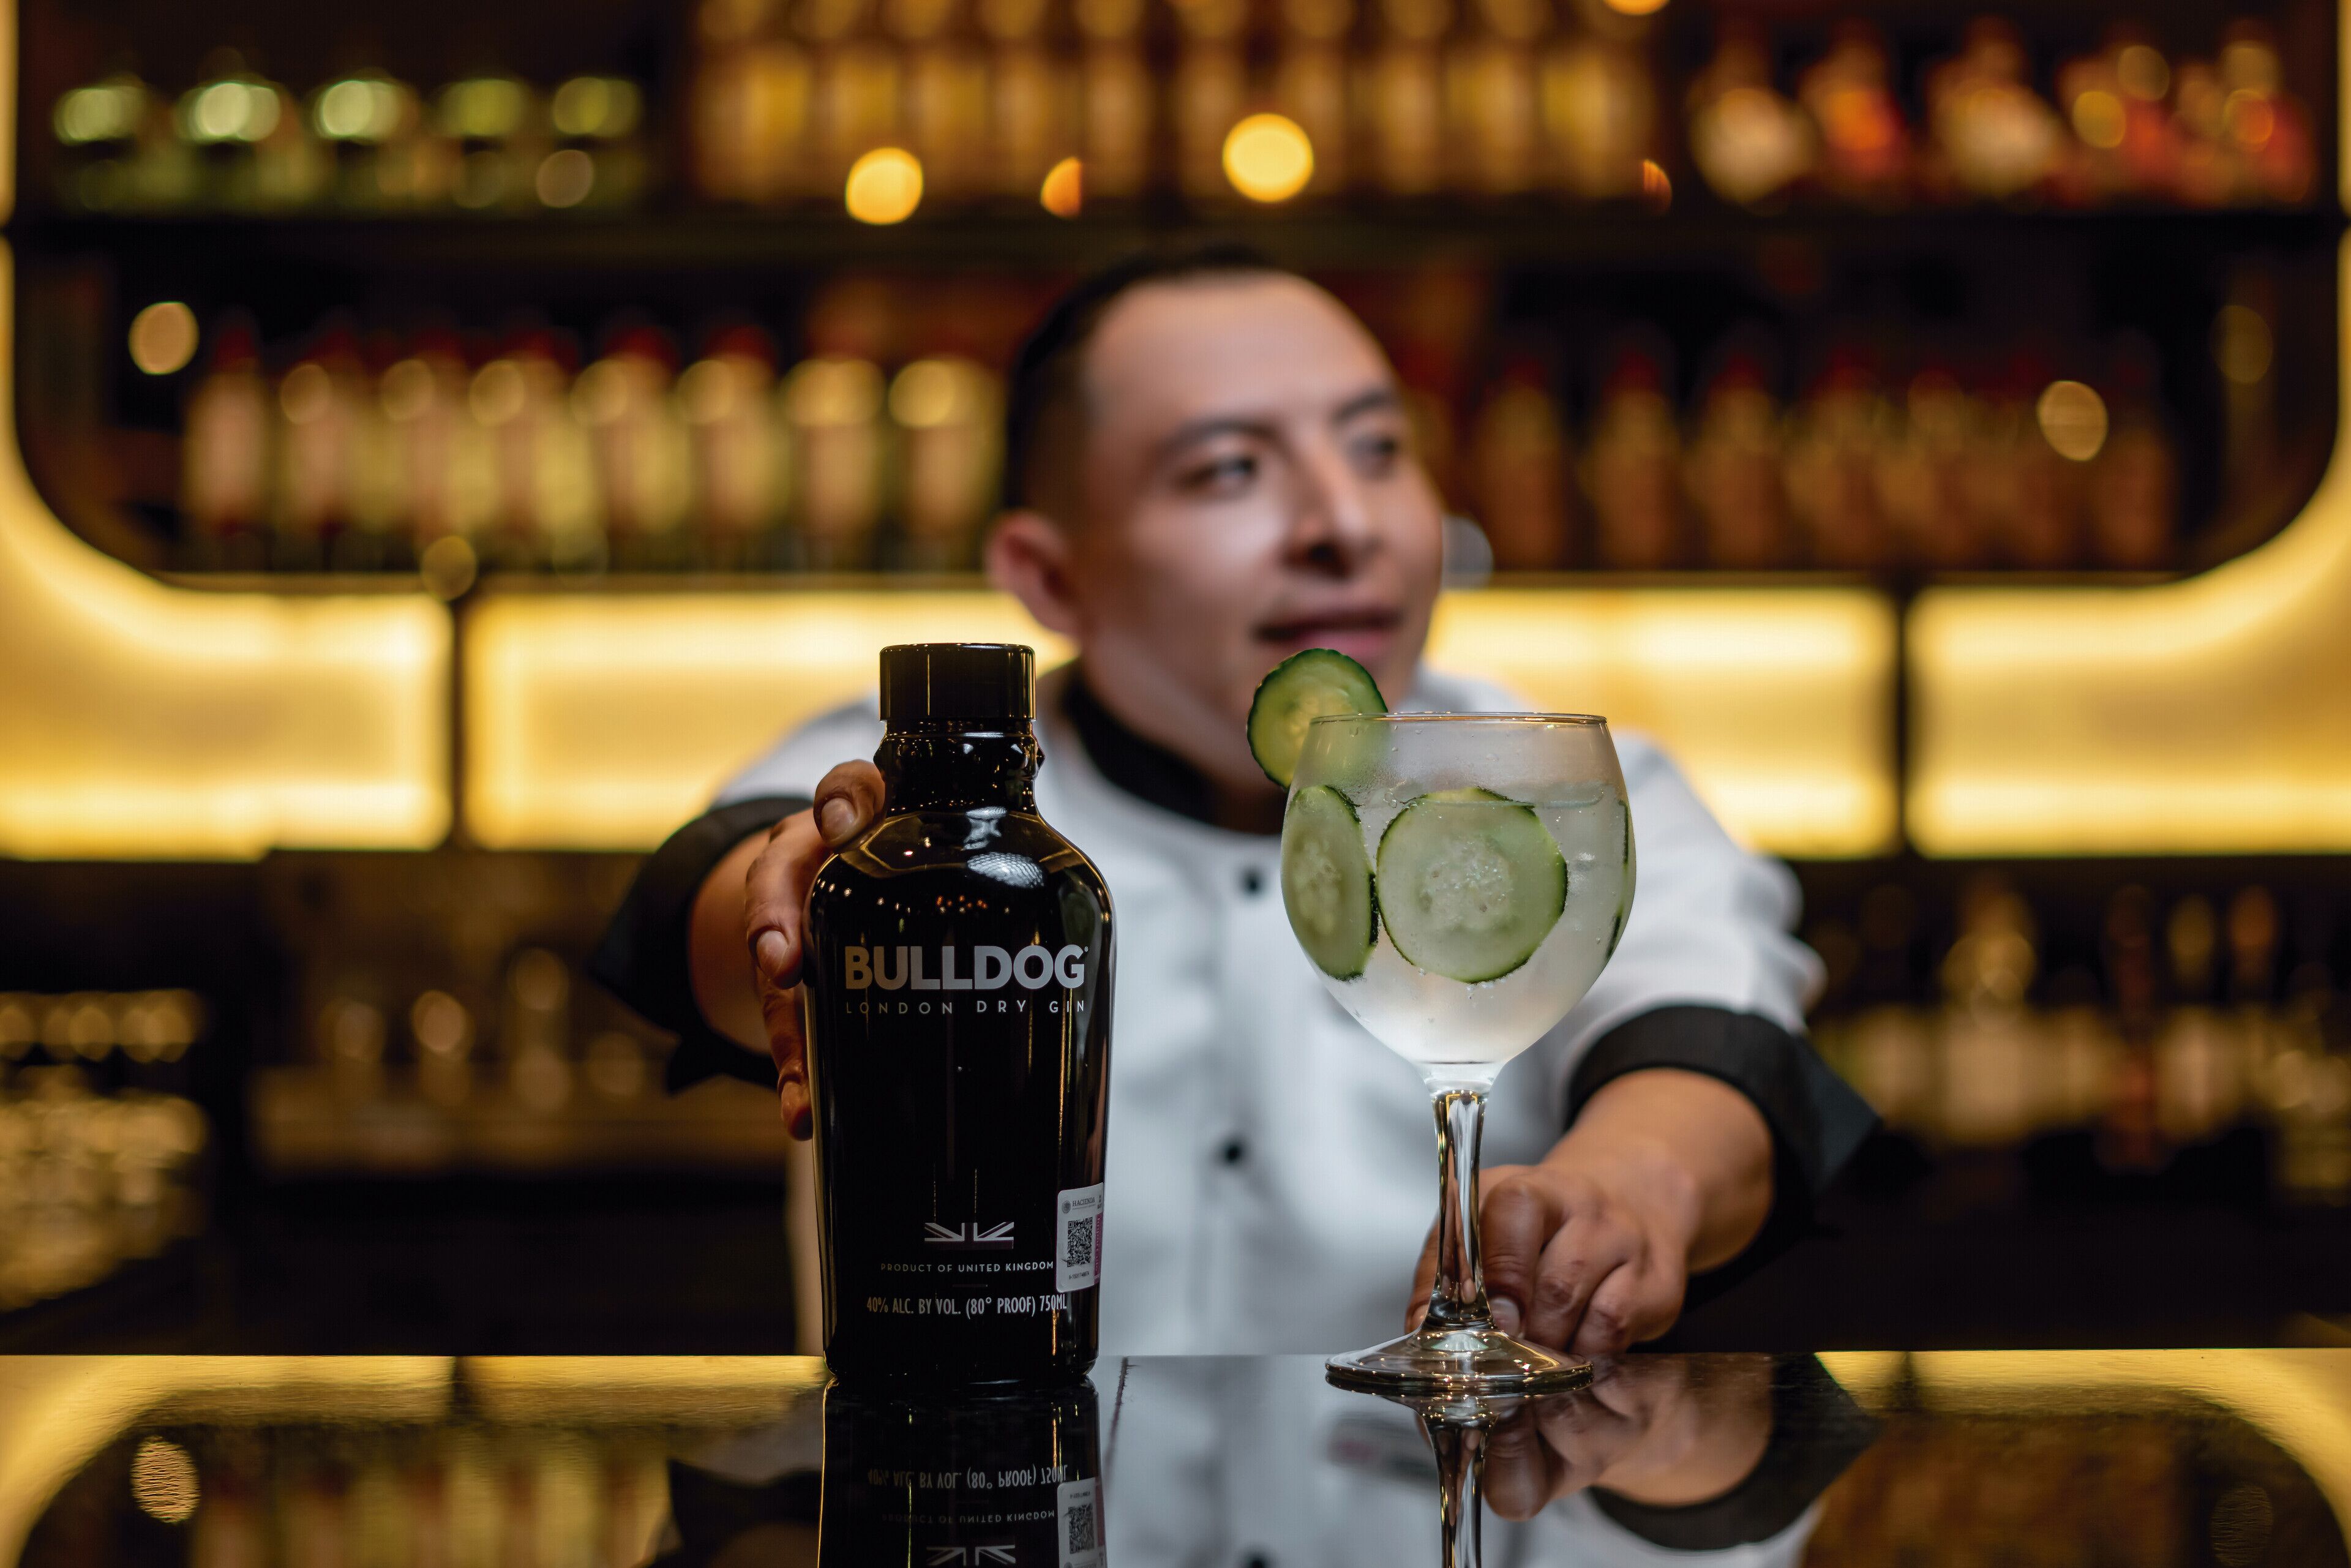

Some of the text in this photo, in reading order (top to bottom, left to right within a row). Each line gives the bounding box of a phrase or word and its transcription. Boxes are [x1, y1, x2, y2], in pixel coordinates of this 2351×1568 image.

[845, 945, 1085, 989] BULLDOG
[846, 1000, 1084, 1015] LONDON DRY GIN
[1072, 1197, 1095, 1206] HACIENDA
[881, 1263, 932, 1272] PRODUCT
[958, 1264, 1000, 1272] UNITED
[1005, 1261, 1054, 1271] KINGDOM
[866, 1294, 1067, 1319] 40% ALC. BY VOL. (80° PROOF) 750ML
